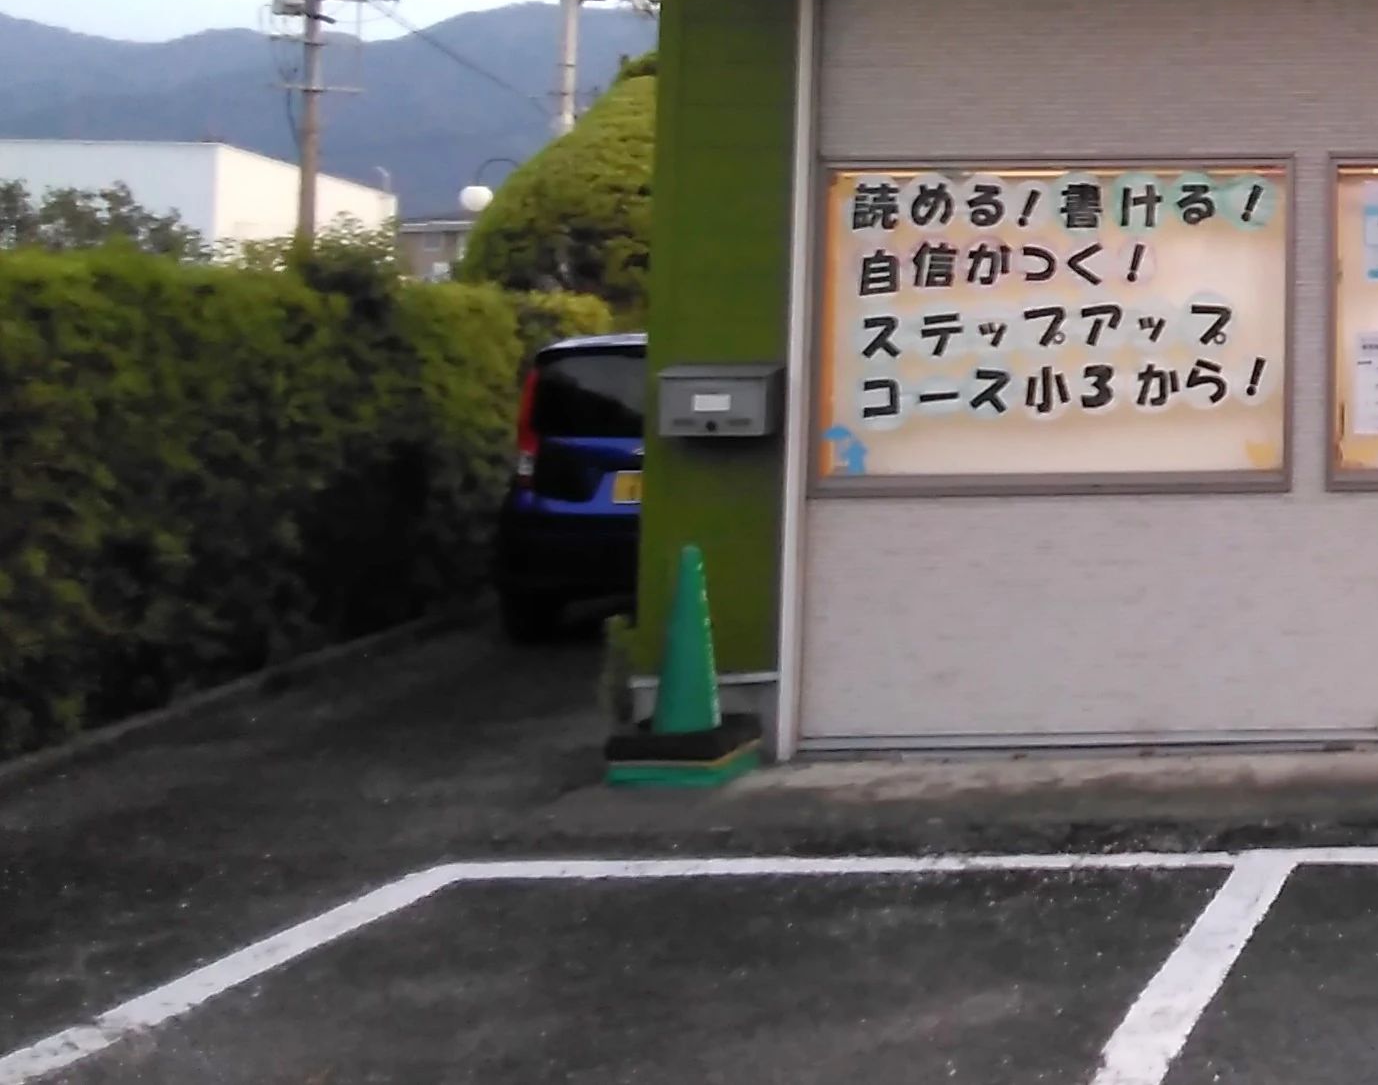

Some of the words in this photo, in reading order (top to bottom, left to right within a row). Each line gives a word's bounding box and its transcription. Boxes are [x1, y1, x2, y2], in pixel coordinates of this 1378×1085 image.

[861, 303, 1232, 359] ステップアップ
